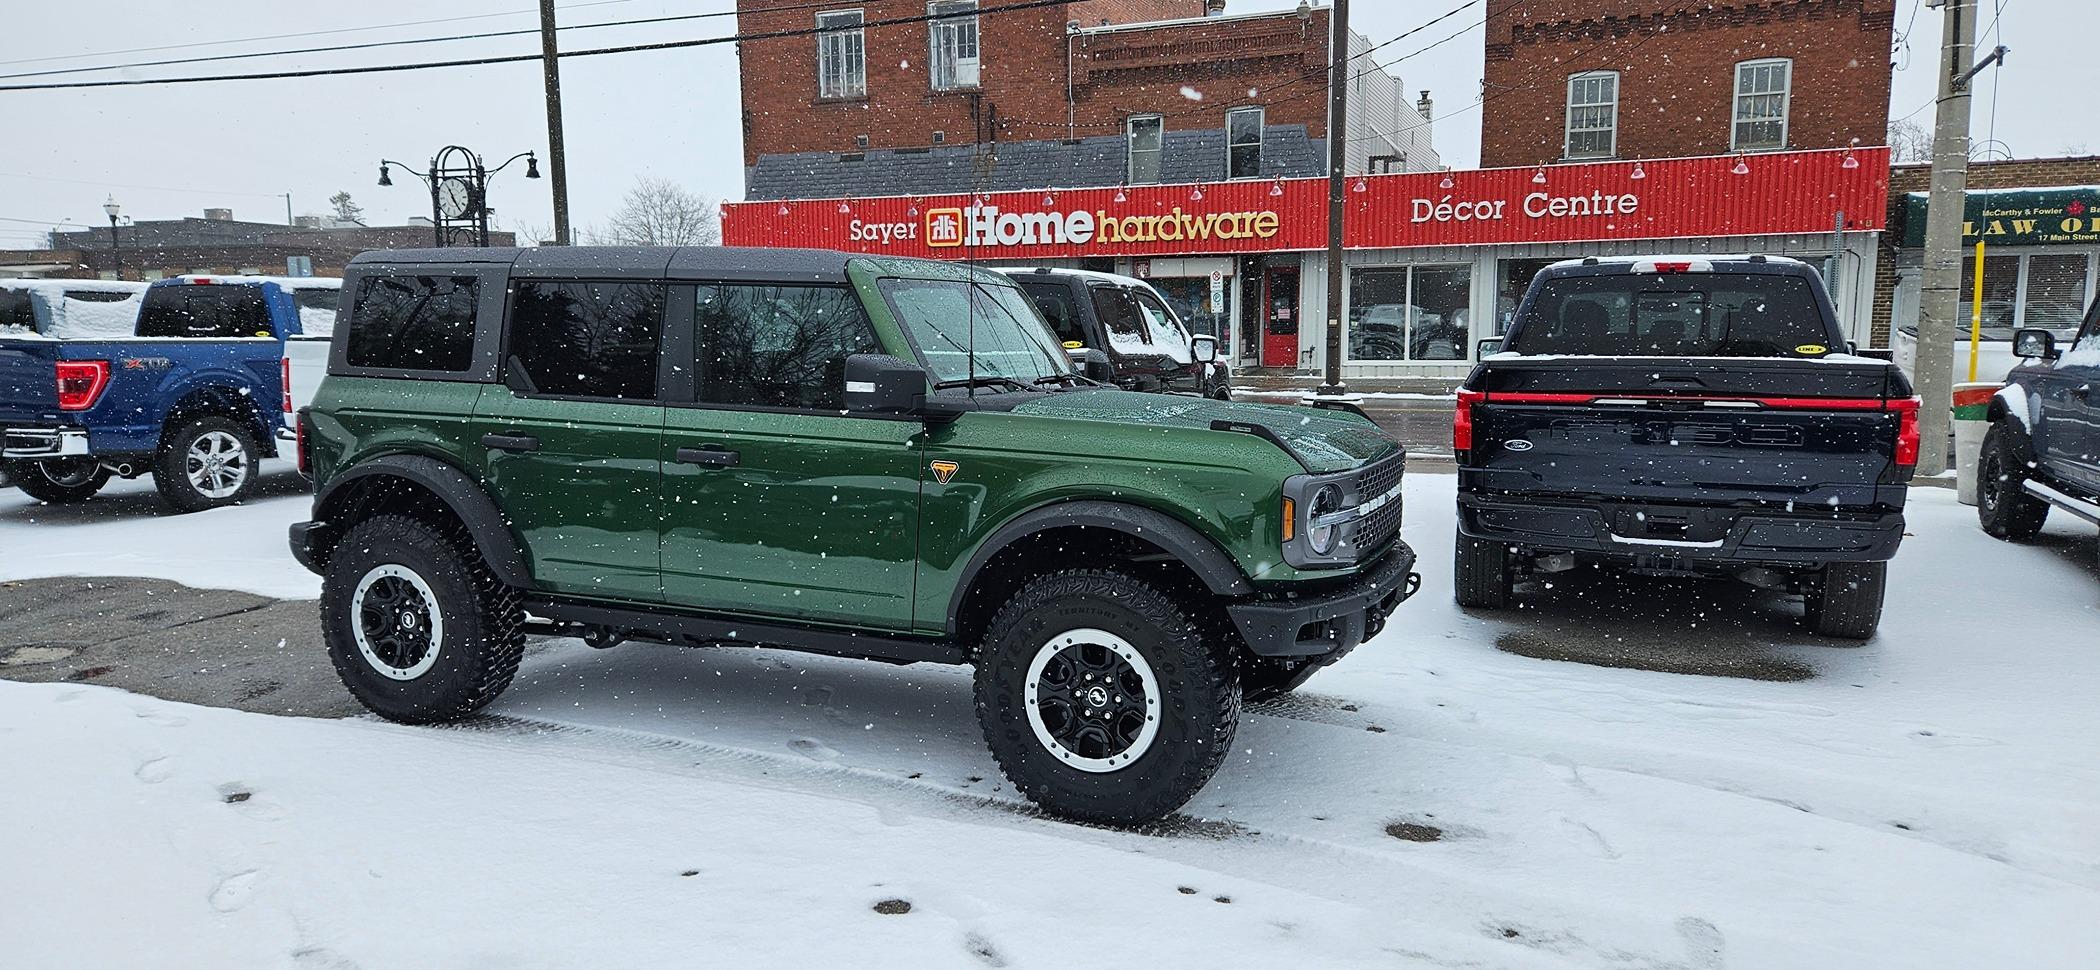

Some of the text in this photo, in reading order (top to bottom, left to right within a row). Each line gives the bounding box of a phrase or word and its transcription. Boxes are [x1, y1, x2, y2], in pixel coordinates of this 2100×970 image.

[1411, 190, 1638, 223] Décor Centre
[1982, 208, 2022, 217] McCarthy
[2033, 207, 2063, 215] Fowler
[850, 206, 1279, 246] Sayer Home hardware
[1962, 219, 2038, 235] LAW
[2072, 233, 2098, 241] Street
